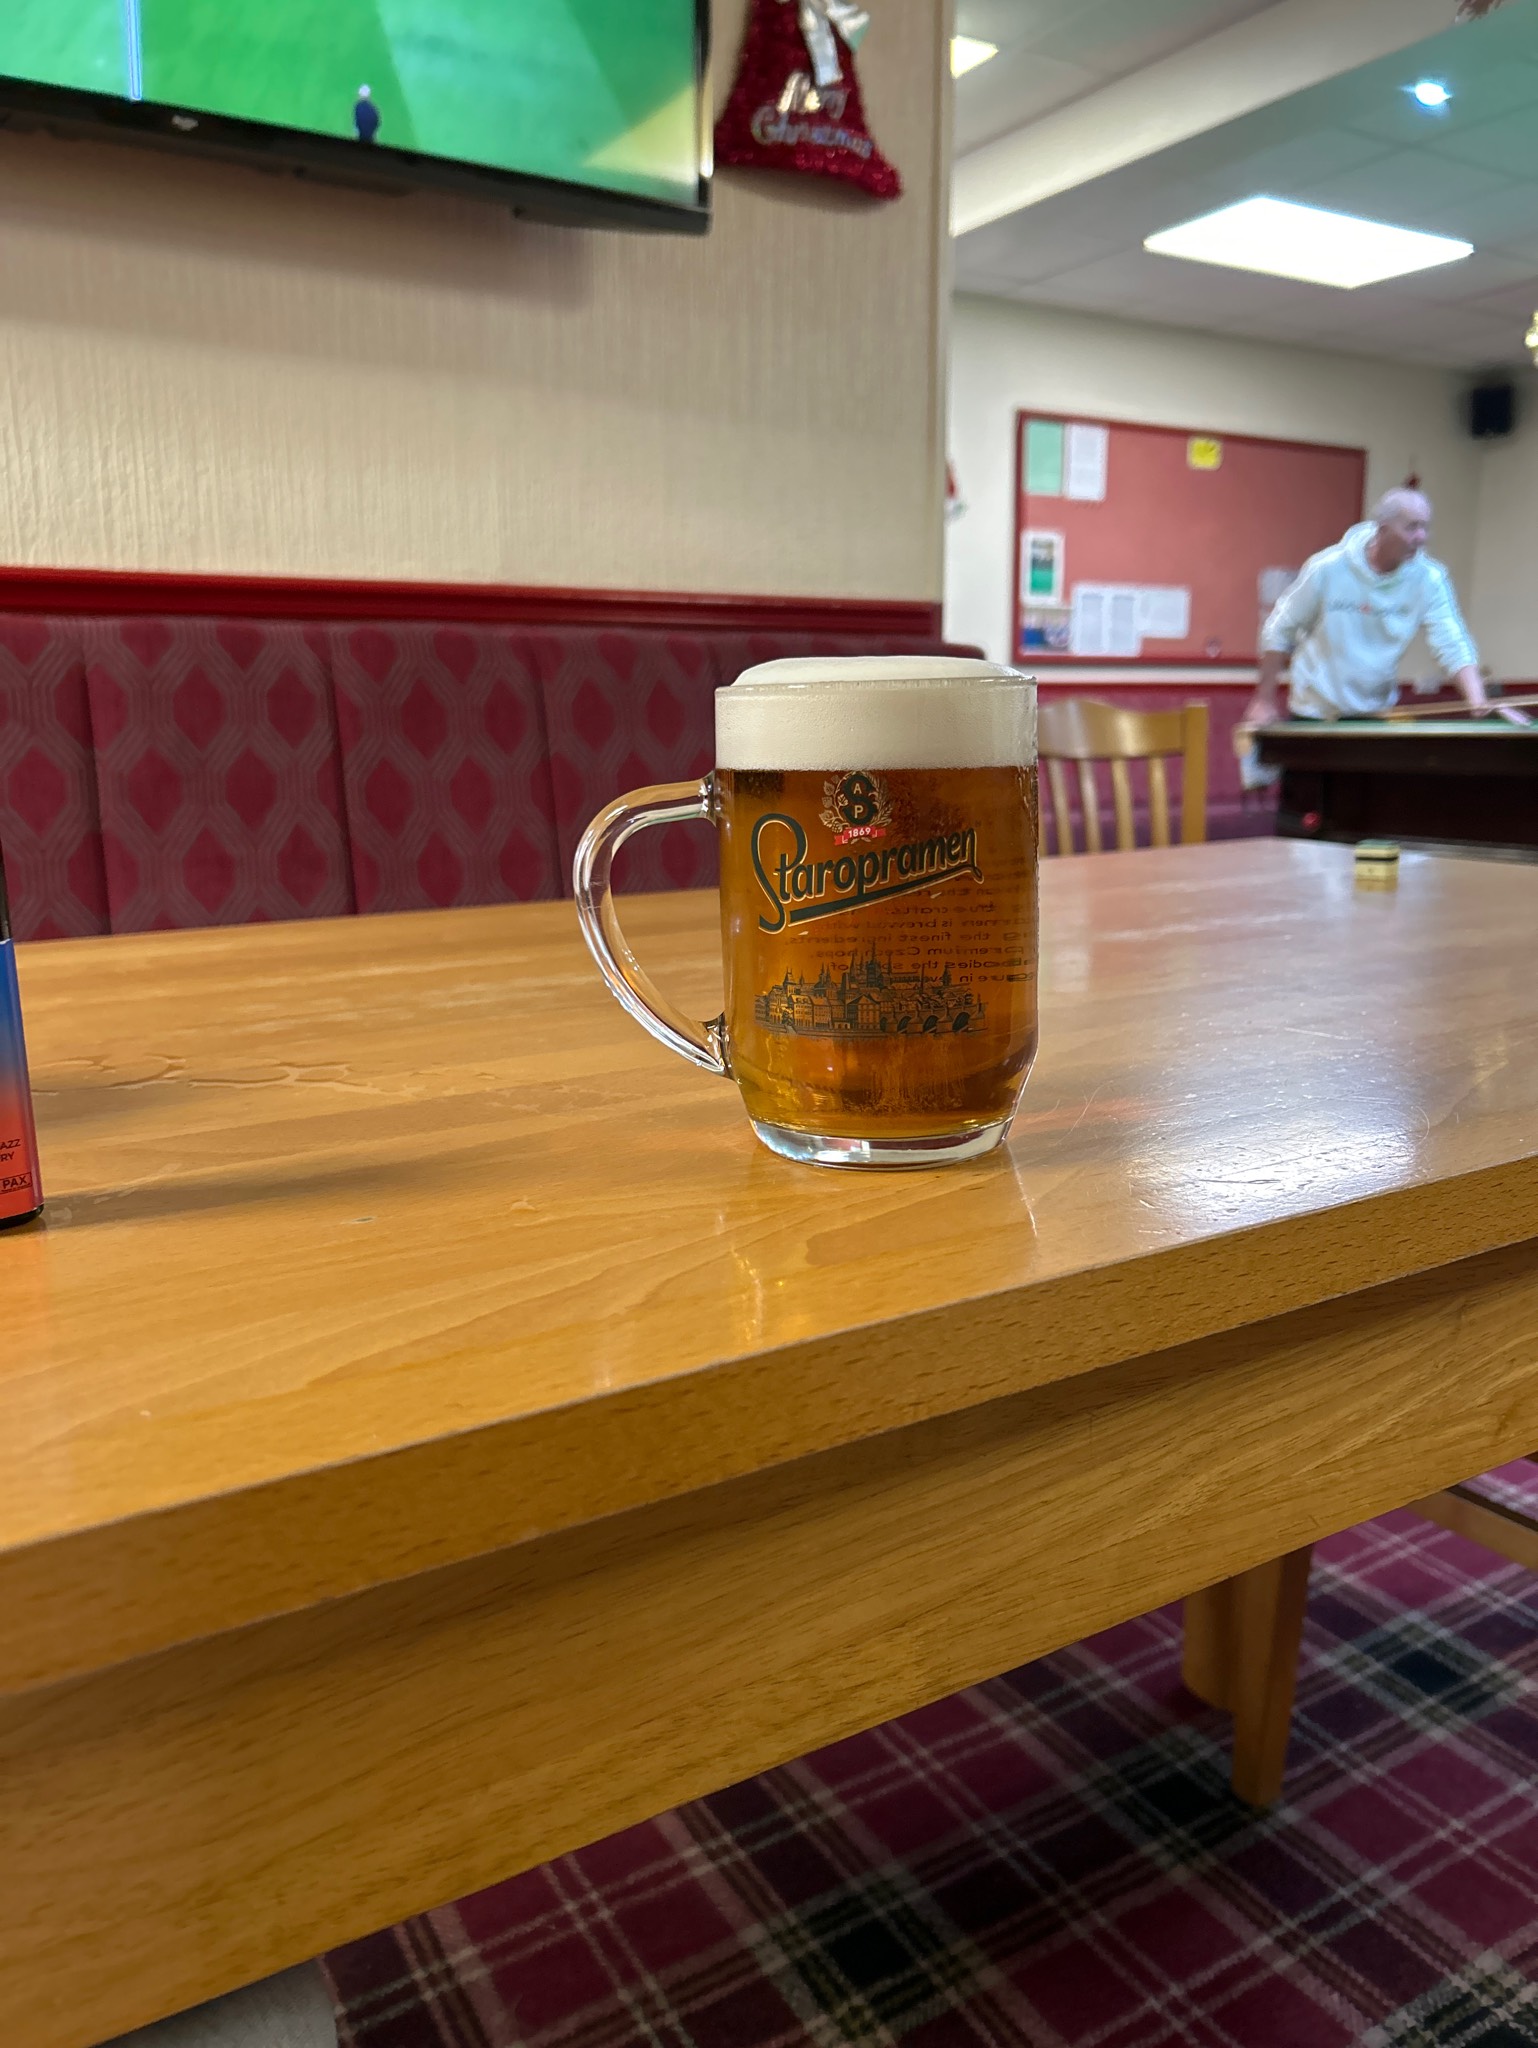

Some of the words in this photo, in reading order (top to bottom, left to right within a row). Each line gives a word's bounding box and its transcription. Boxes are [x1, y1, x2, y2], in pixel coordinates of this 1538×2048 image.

[848, 827, 871, 838] 1869
[751, 813, 980, 934] Staropramen
[0, 1138, 21, 1150] AZZ
[0, 1151, 15, 1162] RY
[3, 1175, 27, 1189] PAX
